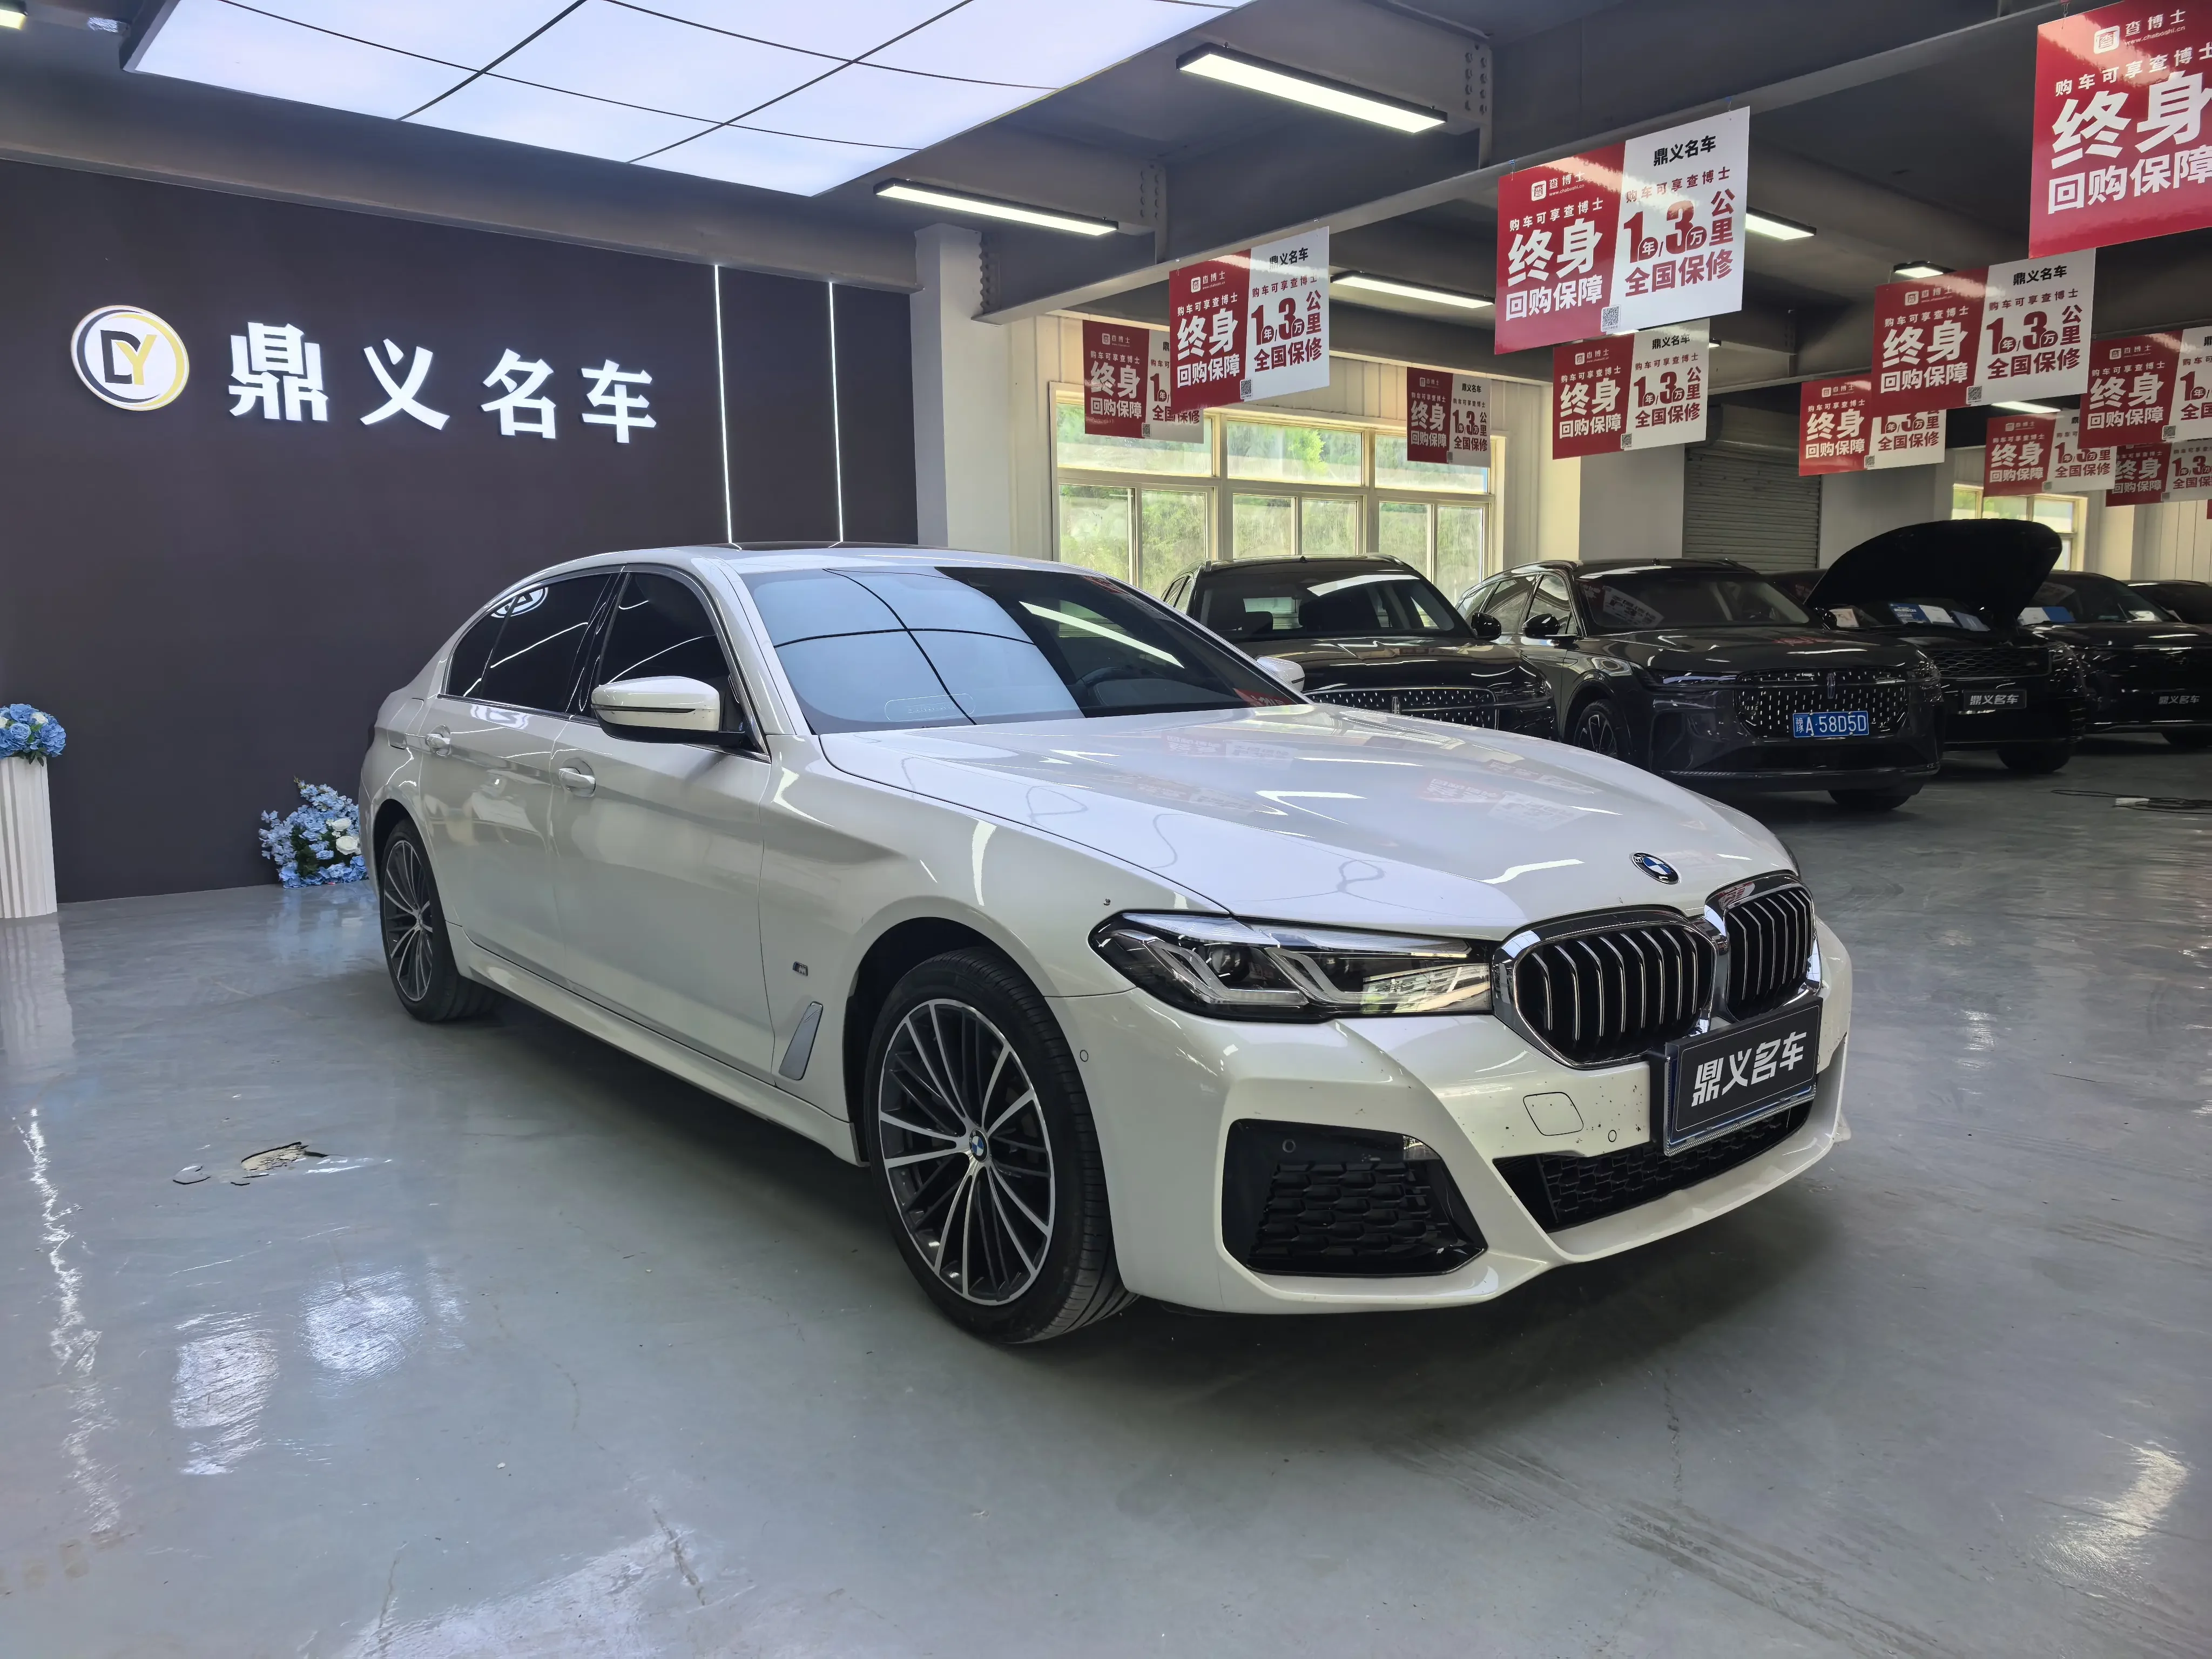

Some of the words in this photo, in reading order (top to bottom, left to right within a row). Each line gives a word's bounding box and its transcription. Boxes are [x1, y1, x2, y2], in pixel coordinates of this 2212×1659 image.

[2126, 9, 2186, 37] 查博士
[2056, 42, 2212, 97] 购车可享查博士
[2051, 70, 2212, 169] 终身
[1654, 136, 1716, 166] 鼎义名车
[1549, 171, 1585, 190] 查博士
[1549, 184, 1584, 197] www.chaboshi.cn
[1626, 166, 1730, 203] 购车可享查博士
[2048, 144, 2212, 214] 回购保障
[1510, 198, 1603, 231] 购车可享查博士
[1270, 247, 1308, 269] 鼎义名车
[1508, 218, 1602, 287] 终身
[1252, 274, 1317, 298] 购车可享查博士
[1625, 249, 1733, 297] 全国保修
[2013, 265, 2067, 285] 鼎义名车
[1178, 292, 1237, 316] 购车可享查博士
[1506, 274, 1602, 321] 回购保障
[1989, 288, 2078, 311] 购车可享查博士
[1884, 306, 1969, 327] 购车可享查博士
[1177, 308, 1238, 360] 终身
[1652, 333, 1690, 349] 鼎义名车
[1883, 320, 1968, 368] 终身
[1091, 351, 1140, 364] 购车可享查博士
[1254, 337, 1321, 372] 全国保修
[1635, 352, 1698, 370] 购车可享查博士
[1987, 348, 2080, 379] 全国保修
[1091, 361, 1140, 399] 终身
[1177, 354, 1239, 388] 回购保障
[1561, 366, 1621, 383] 购车可享查博士
[1880, 362, 1968, 393] 回购保障
[2092, 361, 2165, 376] 购车可享查博士
[228, 322, 657, 444] 鼎义名车
[2089, 372, 2164, 409] 终身
[1091, 397, 1142, 419] 回购保障
[1560, 378, 1621, 417] 终身
[1808, 399, 1865, 412] 购车可享查博士
[1411, 400, 1445, 431] 终身
[1559, 413, 1621, 439] 回购保障
[1635, 402, 1700, 428] 全国保修
[1807, 409, 1864, 441] 终身
[2087, 406, 2163, 430] 回购保障
[1411, 430, 1447, 448] 回购保障
[1454, 436, 1487, 451] 全国保修
[1806, 438, 1865, 459] 回购保障
[1878, 431, 1939, 451] 全国保修
[1991, 441, 2044, 468] 终身
[1990, 467, 2044, 483] 回购保障
[2055, 463, 2110, 478] 全国保修
[2115, 457, 2161, 480] 终身
[2112, 480, 2161, 494] 回购保障
[1970, 694, 2019, 705] 鼎义名车
[1691, 1031, 1808, 1107] 鼎义名车
